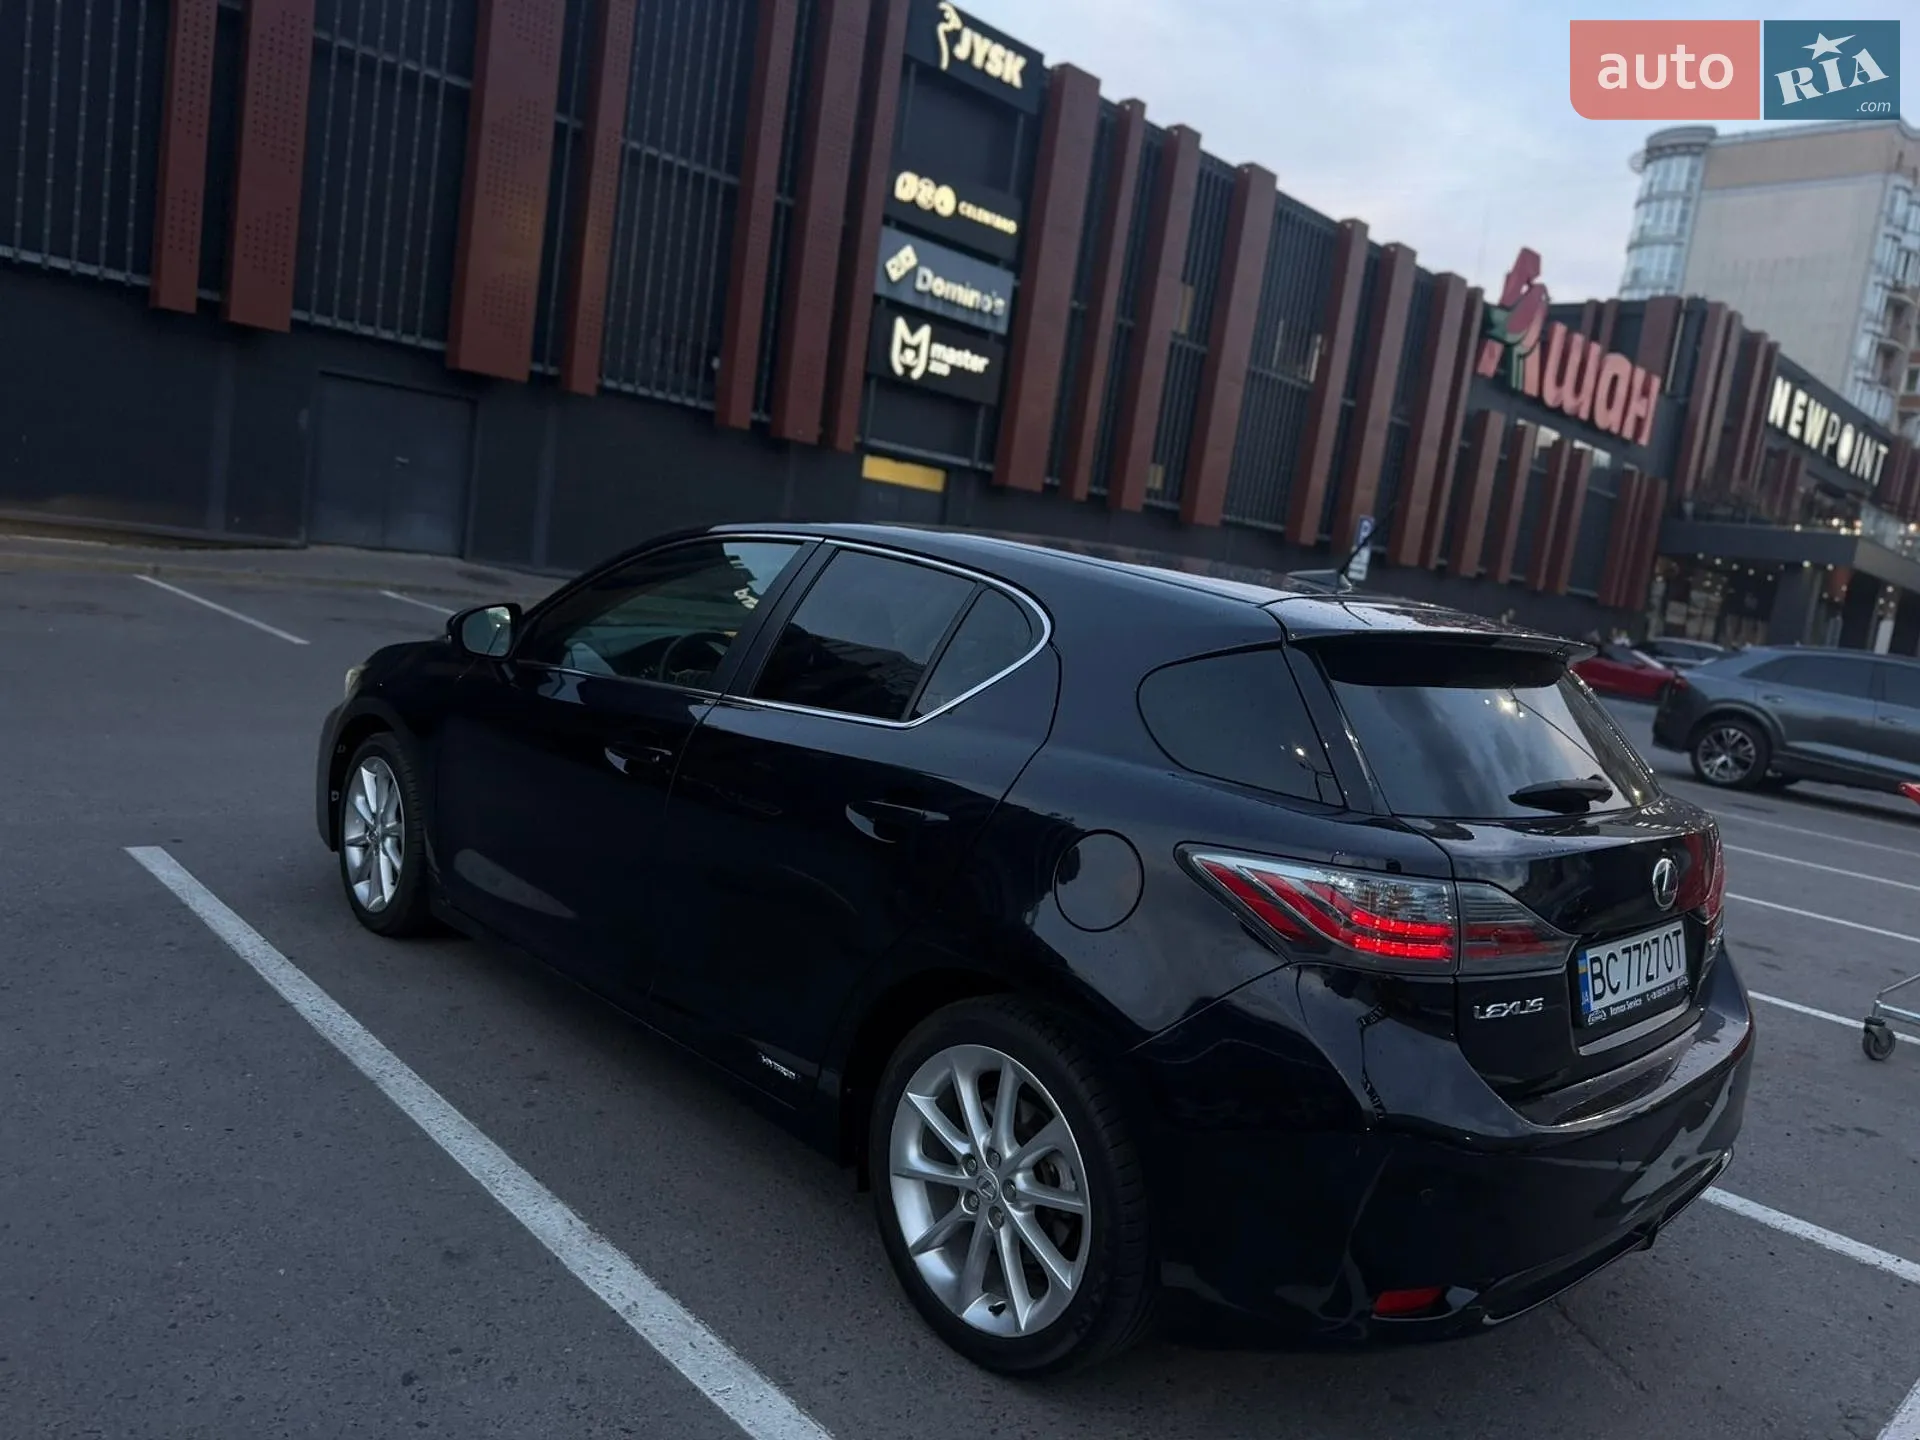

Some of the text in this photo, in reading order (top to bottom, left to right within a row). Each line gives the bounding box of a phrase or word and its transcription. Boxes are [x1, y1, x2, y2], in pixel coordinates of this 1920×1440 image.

[953, 26, 1027, 89] JYSK
[915, 265, 1005, 317] Domino's
[1473, 997, 1545, 1019] LEXUS
